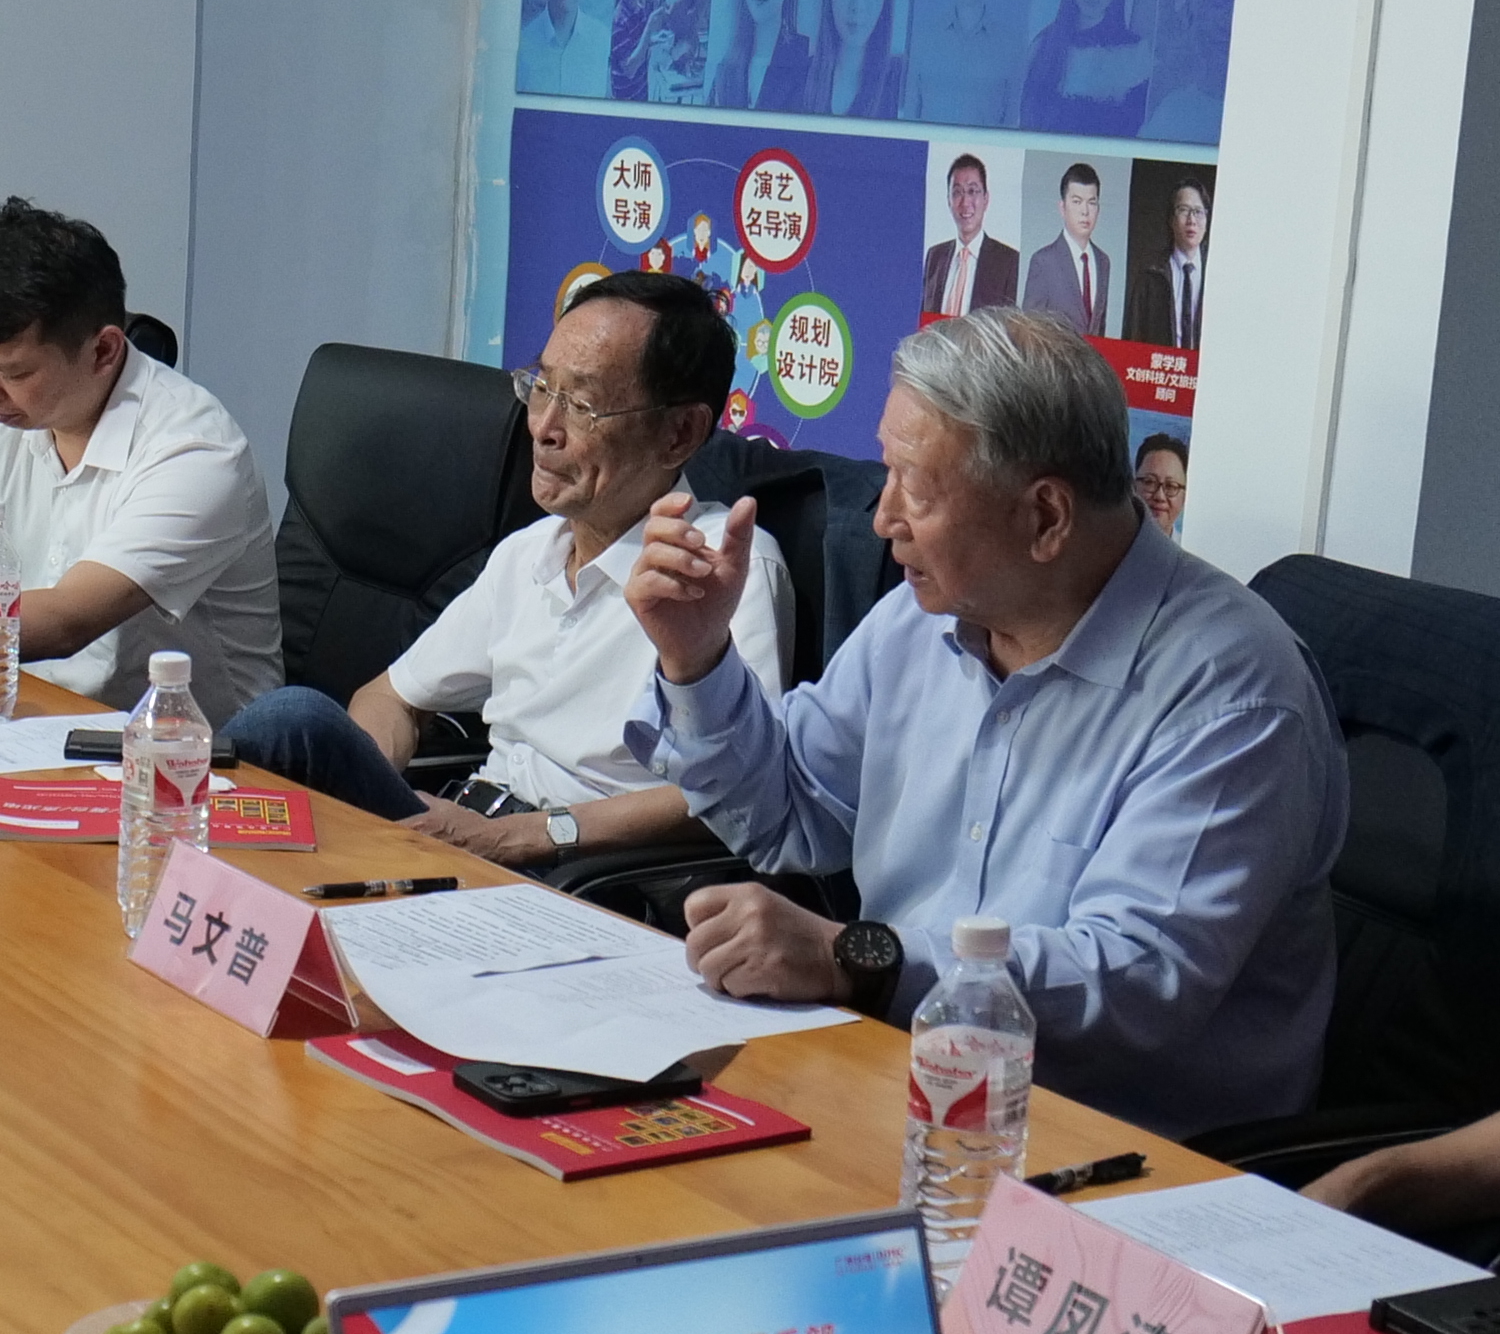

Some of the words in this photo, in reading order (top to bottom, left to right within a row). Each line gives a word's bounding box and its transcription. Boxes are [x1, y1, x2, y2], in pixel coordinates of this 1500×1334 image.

[612, 158, 653, 192] 大师
[753, 169, 795, 203] 演艺
[612, 198, 653, 232] 导演
[745, 207, 803, 242] 名导演
[788, 314, 832, 349] 规划
[776, 349, 840, 389] 设计院
[163, 892, 270, 986] 马文普
